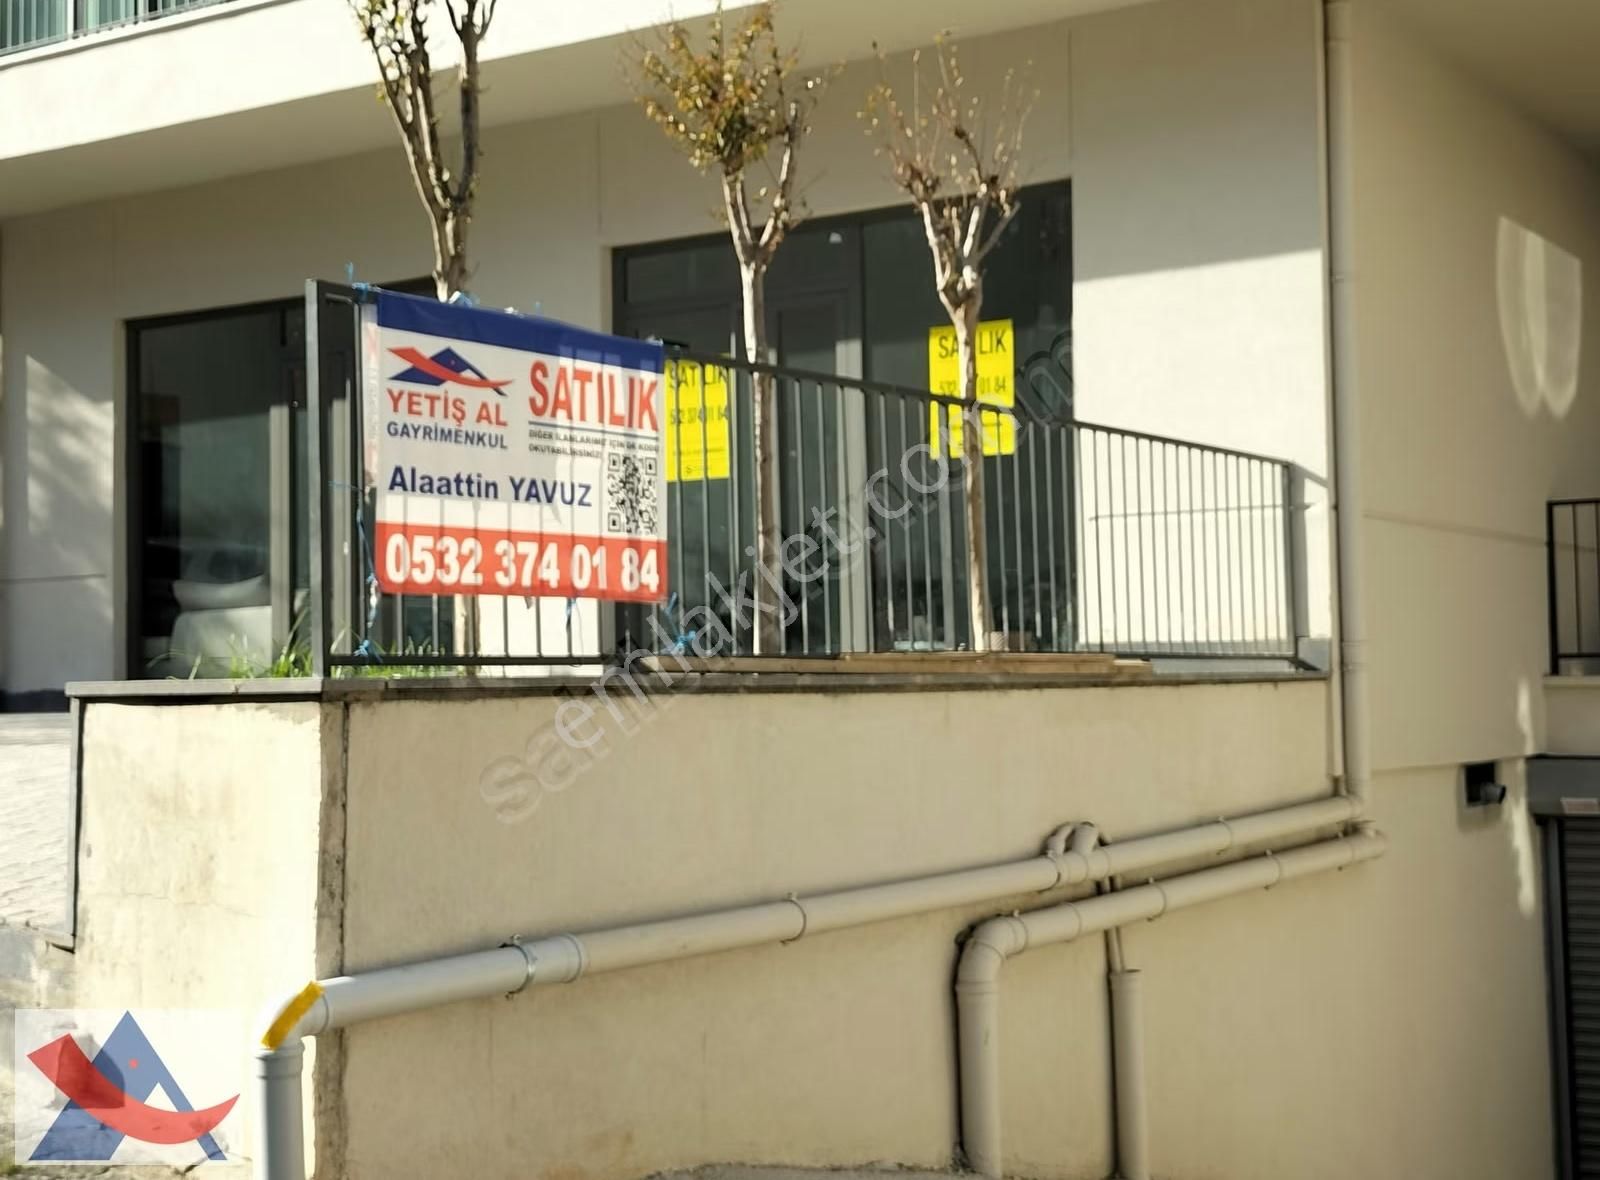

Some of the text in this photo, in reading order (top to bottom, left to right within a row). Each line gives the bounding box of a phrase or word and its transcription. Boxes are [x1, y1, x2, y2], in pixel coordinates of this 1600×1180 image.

[938, 328, 1007, 359] SALIK
[387, 388, 508, 427] YETİŞ AL
[529, 360, 659, 432] SATILIK
[387, 421, 508, 450] GAYRİMENKUL
[388, 465, 593, 507] Alaattin YAVUZ
[385, 532, 660, 592] 0532 374 01 84
